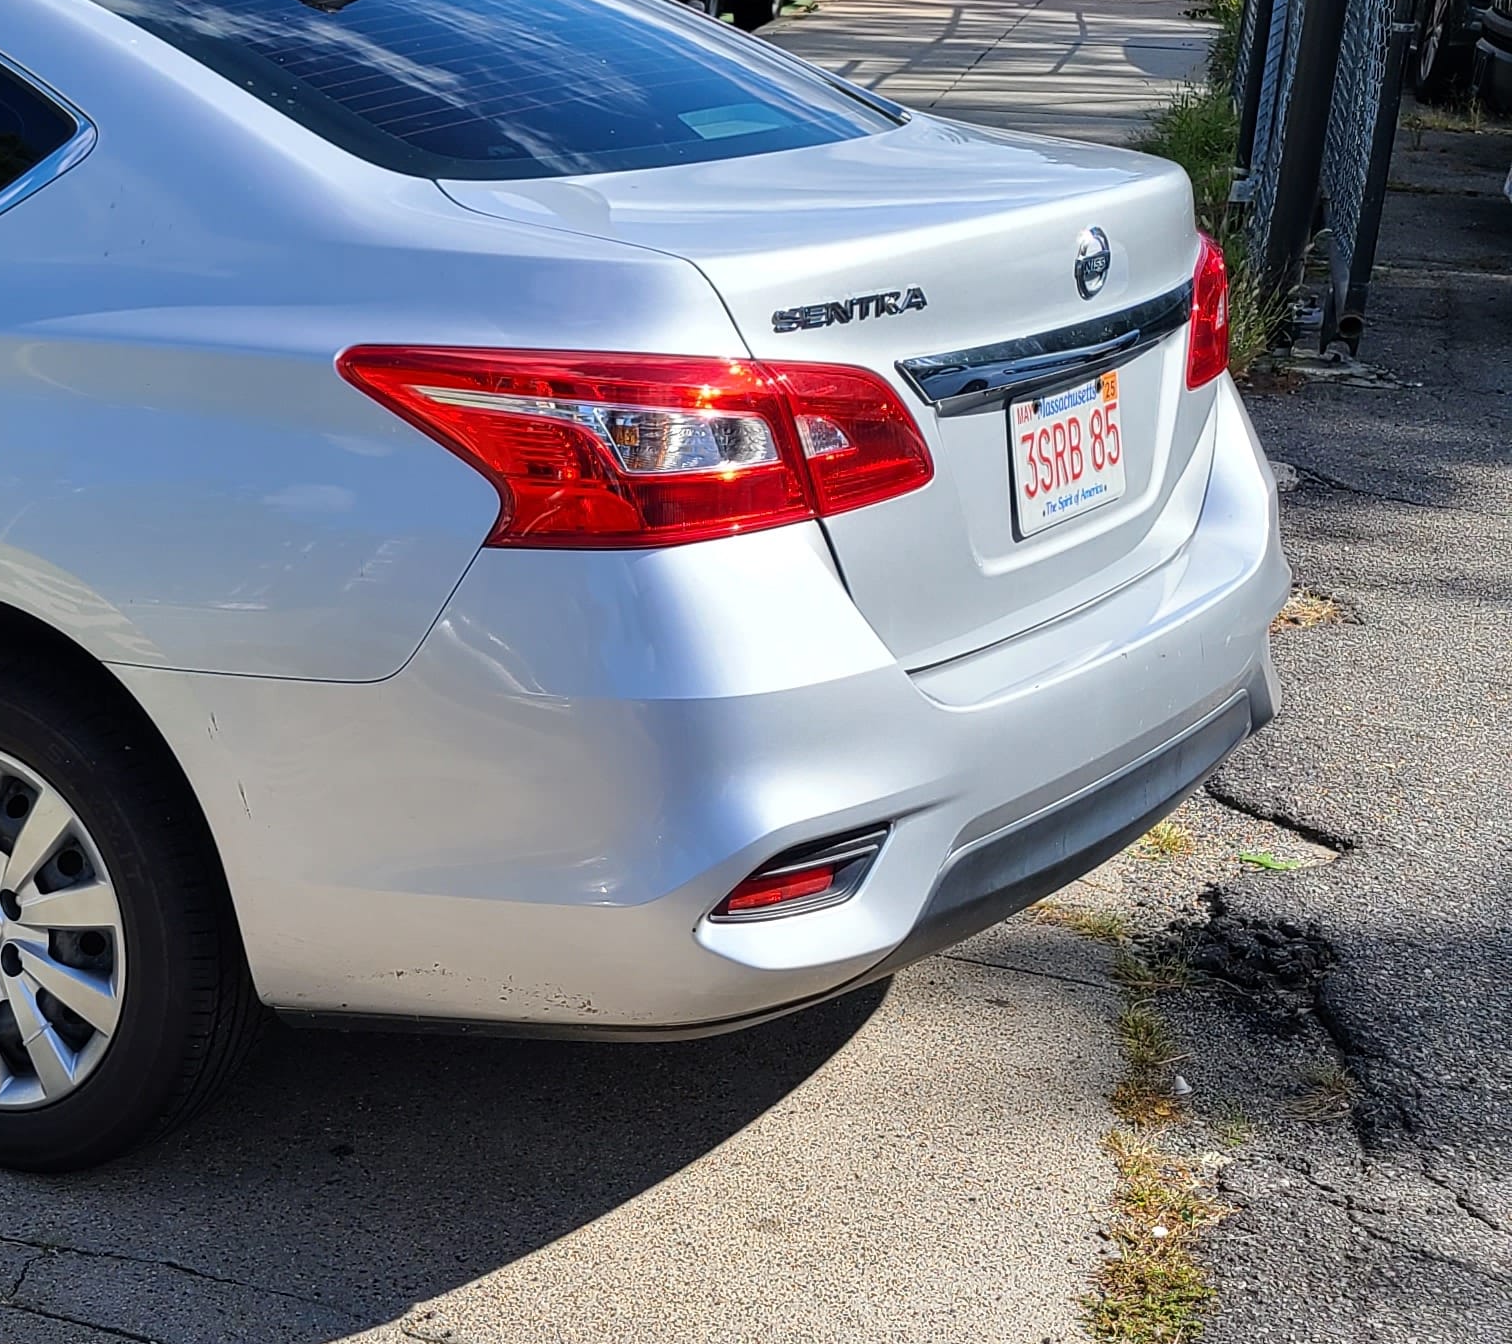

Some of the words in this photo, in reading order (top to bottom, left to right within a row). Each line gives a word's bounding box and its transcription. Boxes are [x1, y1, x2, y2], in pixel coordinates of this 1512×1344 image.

[772, 285, 928, 333] SENTRA
[1017, 405, 1033, 425] MAY
[1038, 386, 1096, 418] Massachusetts
[1021, 417, 1084, 500] 3SRB
[1090, 403, 1120, 471] 85
[1046, 499, 1058, 515] The
[1058, 493, 1074, 510] Spirit
[1081, 484, 1103, 500] America
